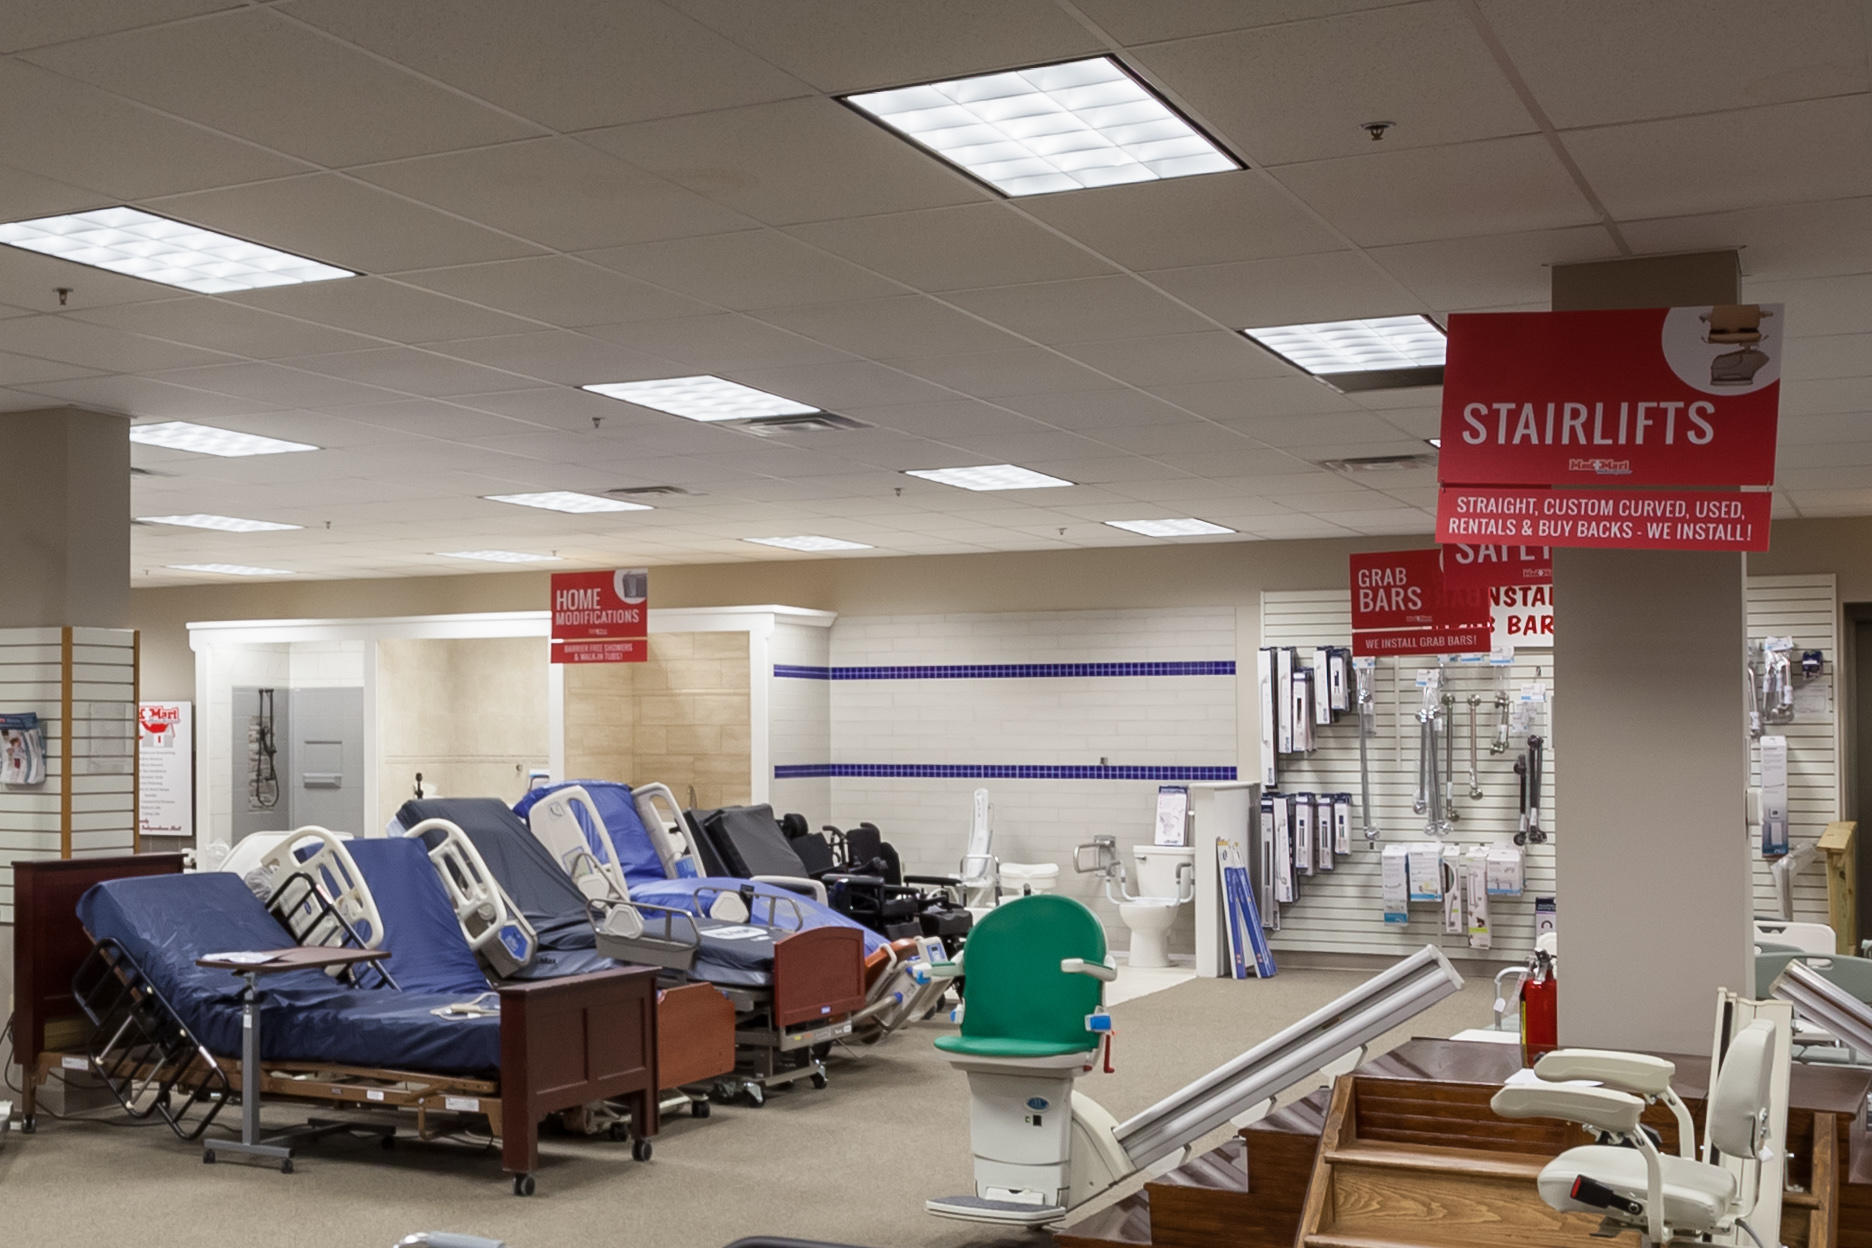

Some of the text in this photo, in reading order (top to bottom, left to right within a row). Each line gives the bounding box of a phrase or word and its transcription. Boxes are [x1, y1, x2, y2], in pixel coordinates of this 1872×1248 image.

[1462, 401, 1716, 446] STAIRLIFTS
[1457, 496, 1745, 520] STRAIGHT, CUSTOM CURVED, USED,
[1448, 518, 1516, 536] RENTALS
[1521, 519, 1533, 536] &
[1539, 520, 1572, 537] BUY
[1578, 521, 1632, 539] BACKS
[1647, 522, 1671, 540] WE
[1677, 523, 1752, 542] INSTALL!
[1358, 567, 1407, 588] GRAB
[556, 588, 601, 610] HOME
[1359, 587, 1422, 612] BARS
[556, 609, 640, 626] MODIFICATIONS
[1507, 615, 1554, 635] BAR
[1365, 635, 1477, 649] WE INSTALL GRAB BARS!
